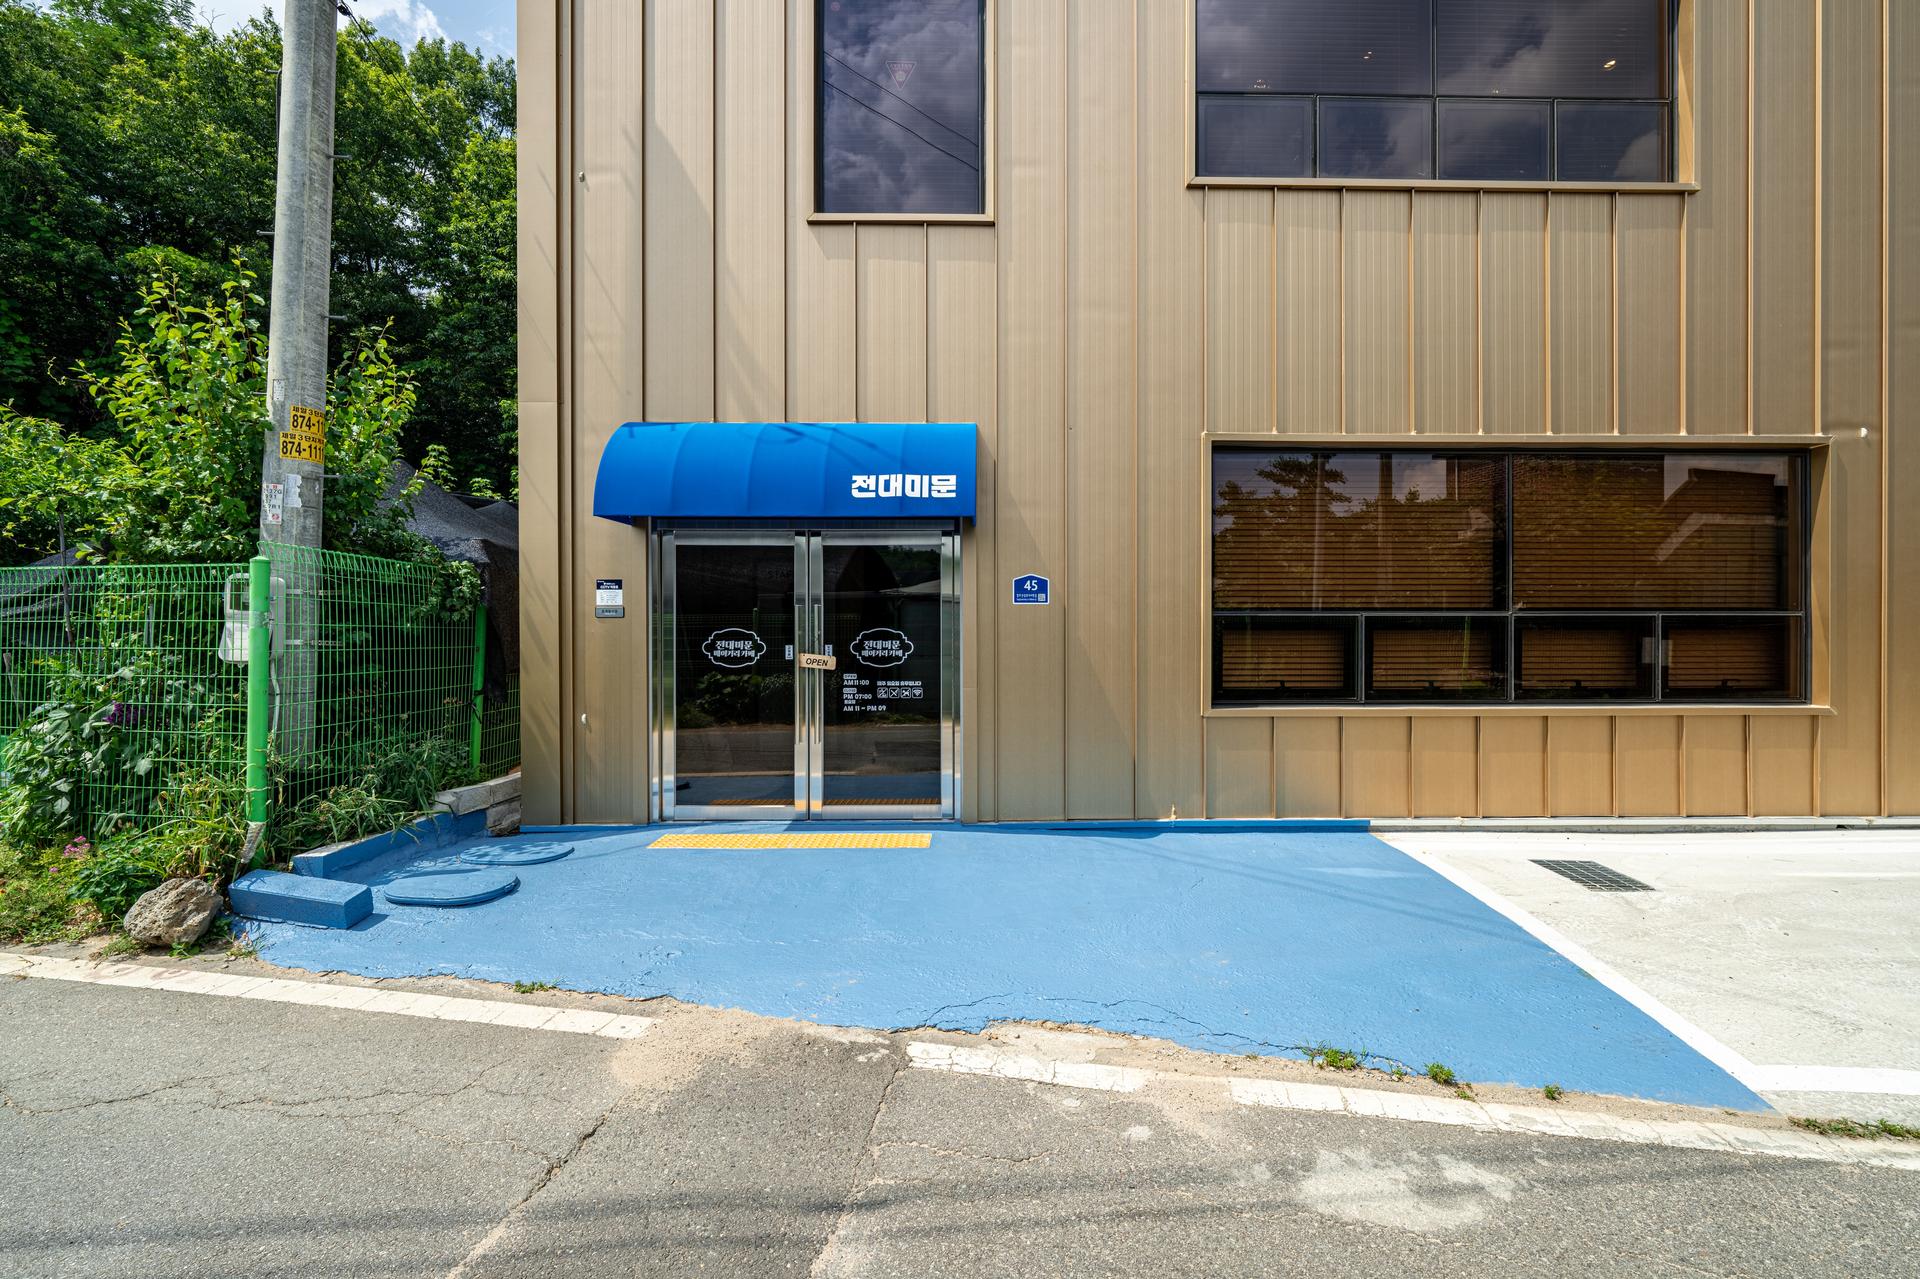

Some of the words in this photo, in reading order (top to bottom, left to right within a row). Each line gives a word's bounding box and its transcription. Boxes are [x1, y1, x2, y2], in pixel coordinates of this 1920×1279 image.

[851, 474, 957, 498] 전대미문
[1023, 580, 1038, 591] 45
[715, 640, 753, 650] 전대미문
[863, 640, 900, 650] 전대미문
[805, 658, 829, 667] OPEN
